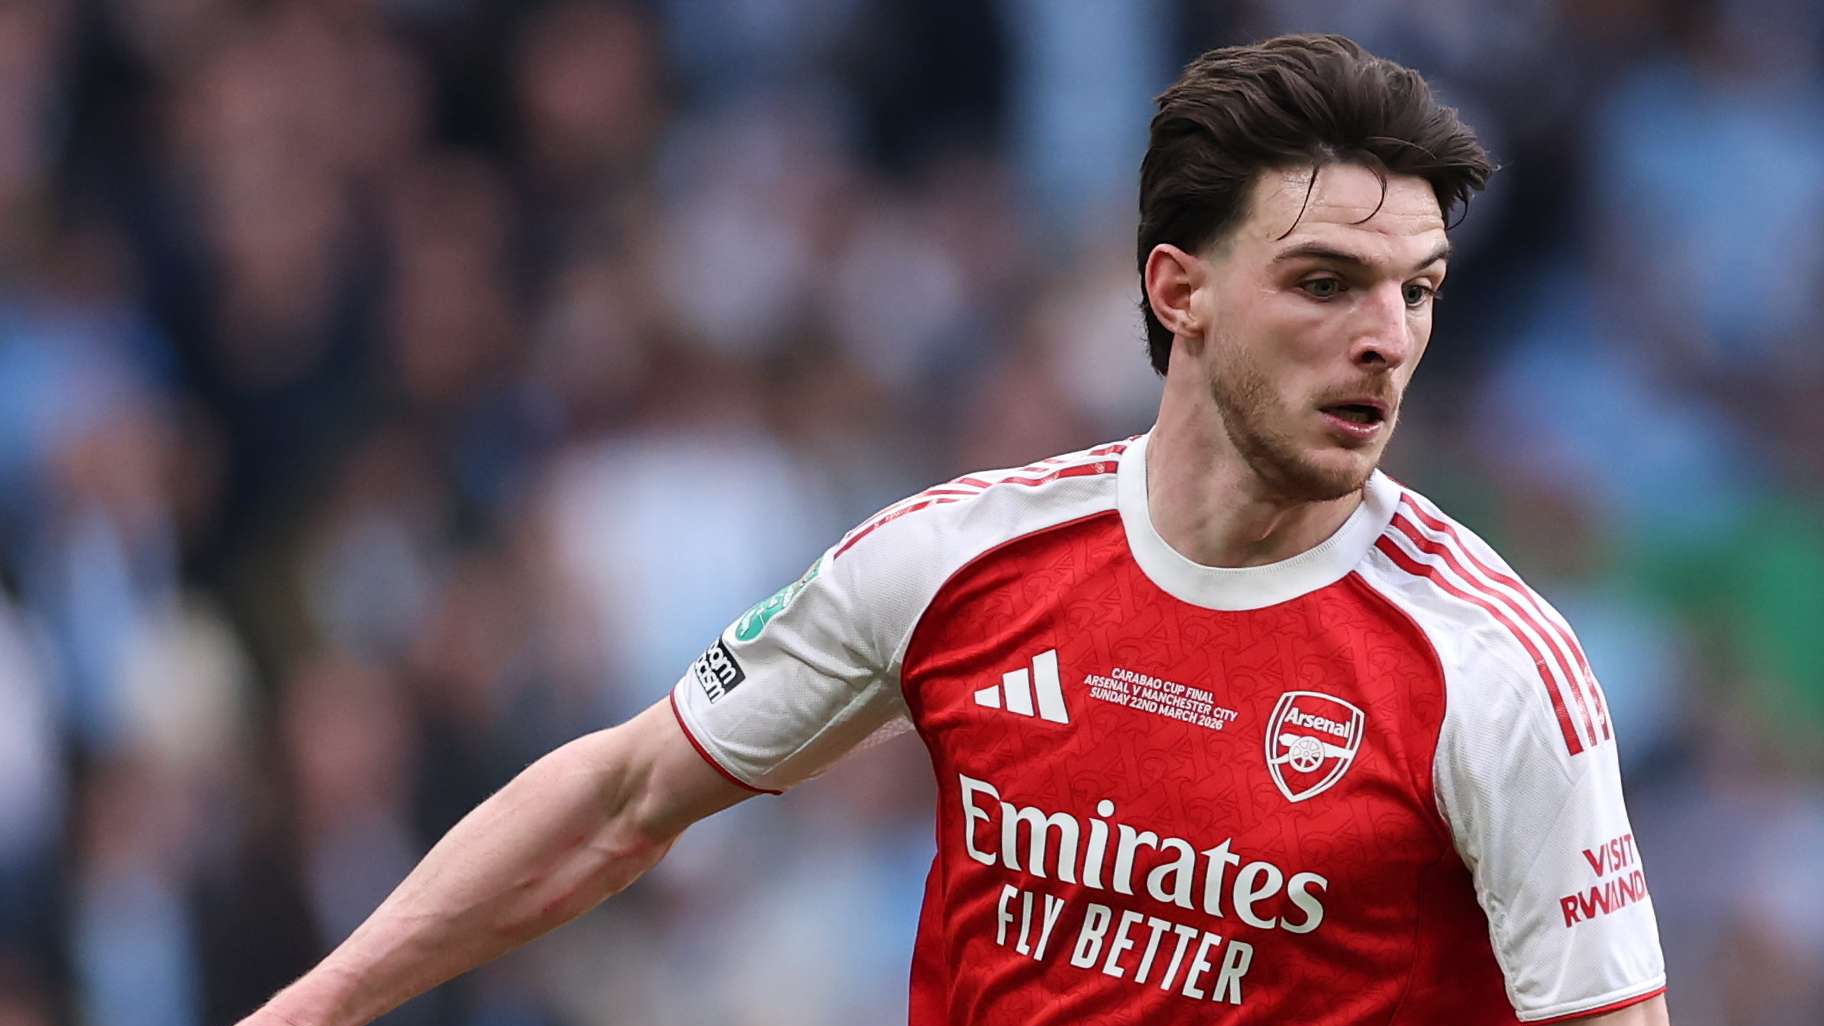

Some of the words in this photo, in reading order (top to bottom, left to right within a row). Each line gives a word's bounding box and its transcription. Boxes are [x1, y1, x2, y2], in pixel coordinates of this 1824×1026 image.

[1083, 674, 1130, 694] ARSENAL
[1132, 684, 1141, 696] V
[1141, 687, 1212, 715] MANCHESTER
[1213, 706, 1239, 722] CITY
[1089, 686, 1131, 706] SUNDAY
[1129, 696, 1158, 713] 22ND
[1157, 704, 1198, 724] MARCH
[1197, 714, 1224, 730] 2026
[1111, 667, 1162, 690] CARABAO
[1163, 681, 1185, 695] CUP
[1185, 686, 1215, 704] FINAL
[1284, 707, 1351, 738] Arsenal
[958, 771, 1330, 935] Emirates
[1582, 833, 1635, 878] VISIT
[1559, 869, 1647, 929] RWAND
[995, 883, 1065, 961] FLY
[1070, 903, 1255, 1006] BETTER
